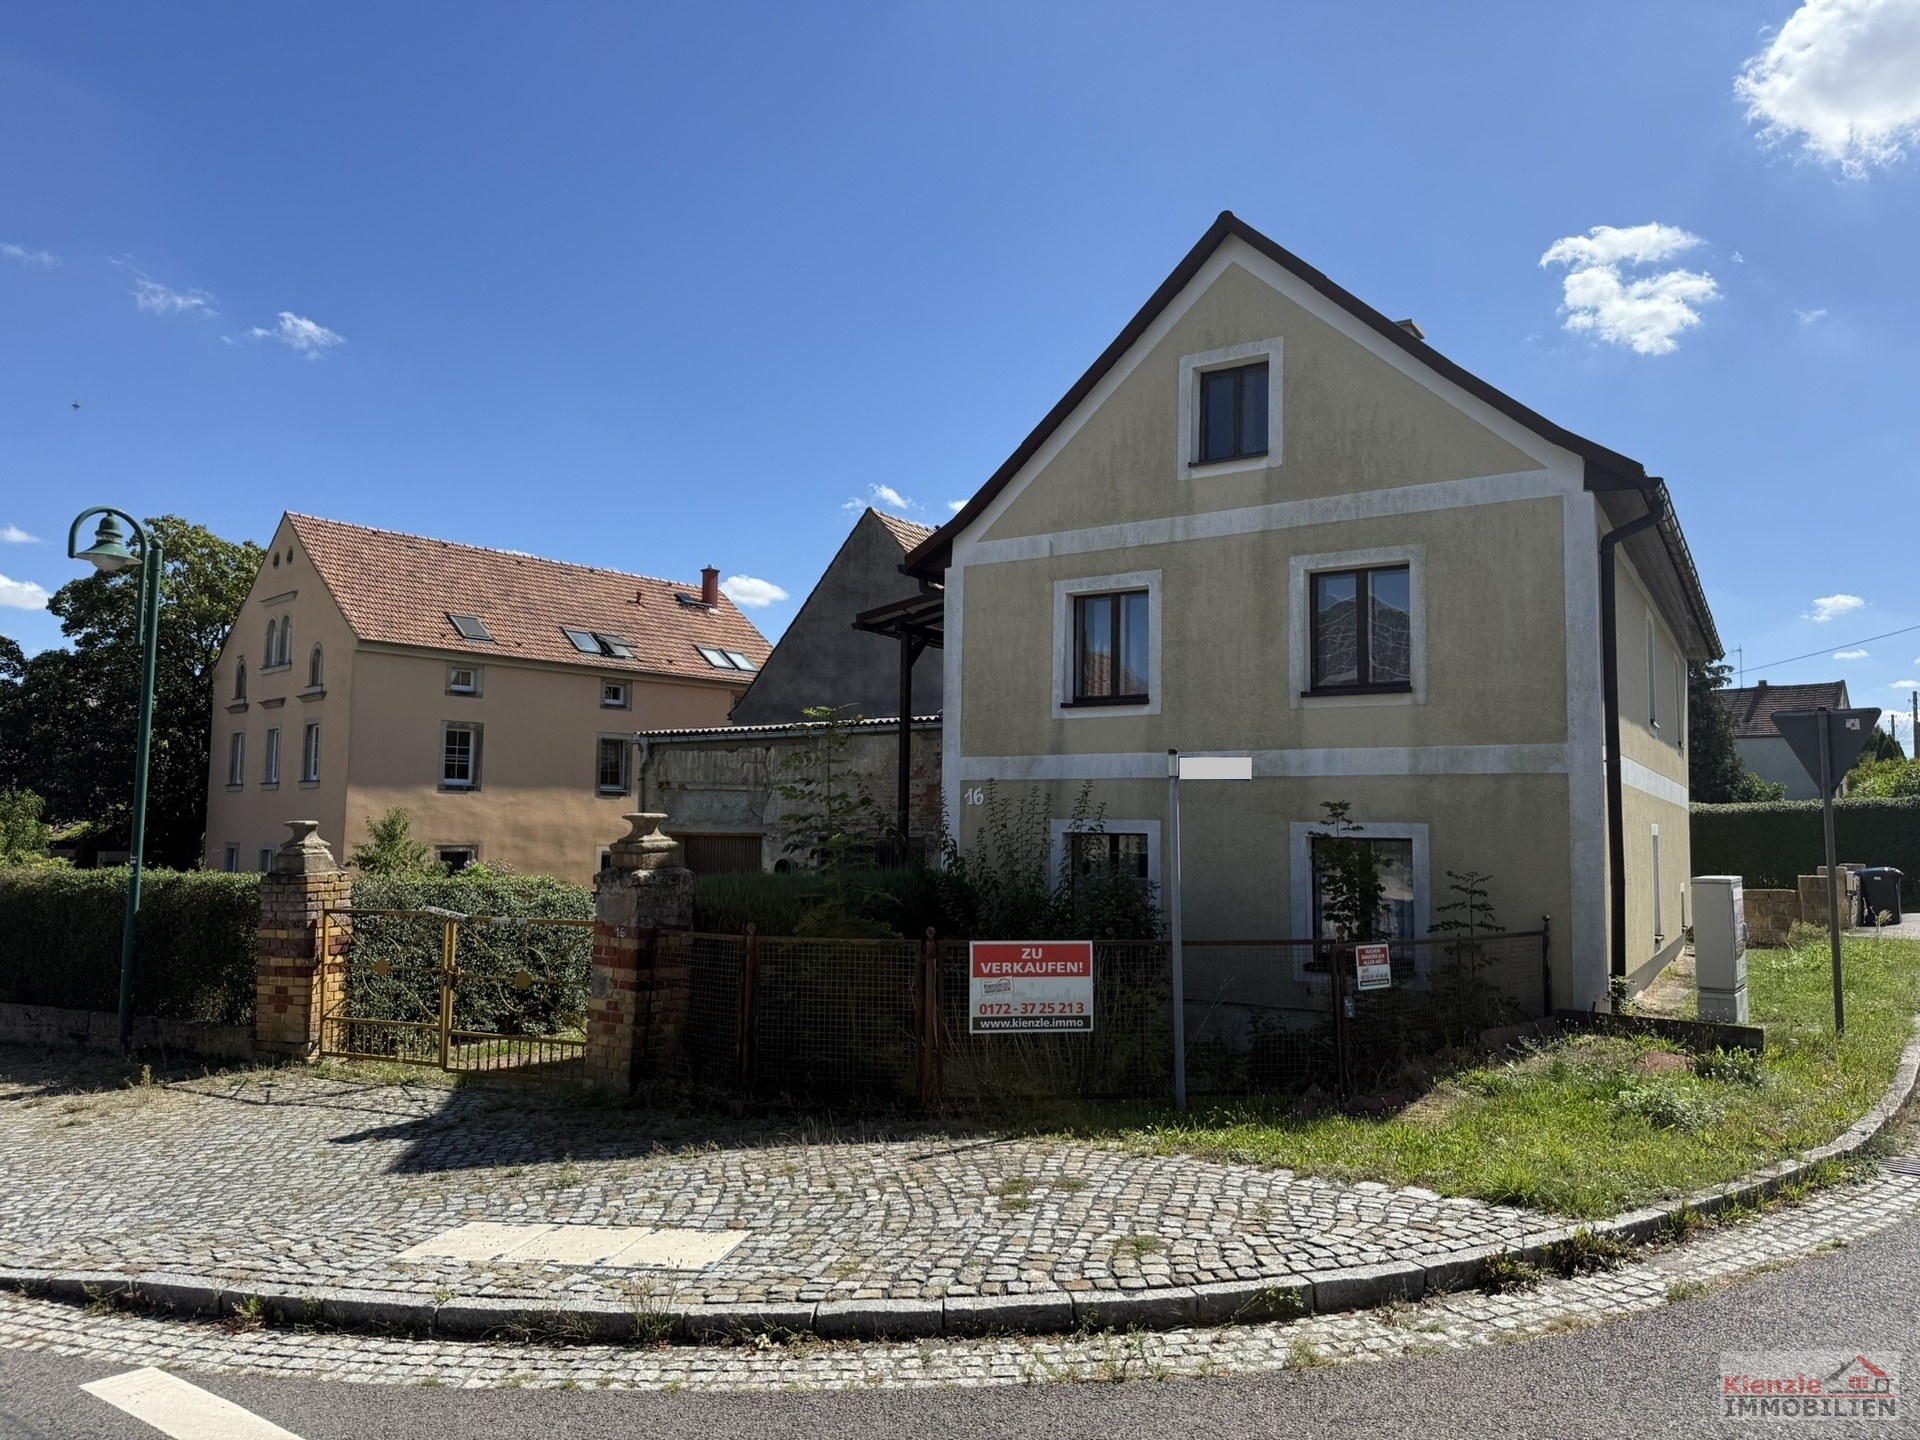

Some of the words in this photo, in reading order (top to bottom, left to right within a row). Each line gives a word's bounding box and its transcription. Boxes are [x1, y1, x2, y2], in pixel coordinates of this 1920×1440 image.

[964, 786, 984, 806] 16
[616, 927, 626, 938] 16
[1021, 948, 1042, 959] ZU
[980, 962, 1083, 973] VERKAUFEN!
[979, 1003, 1011, 1015] 0172
[1020, 1003, 1036, 1014] 37
[1038, 1003, 1056, 1014] 25
[980, 1018, 1084, 1028] www.kienzle.immo
